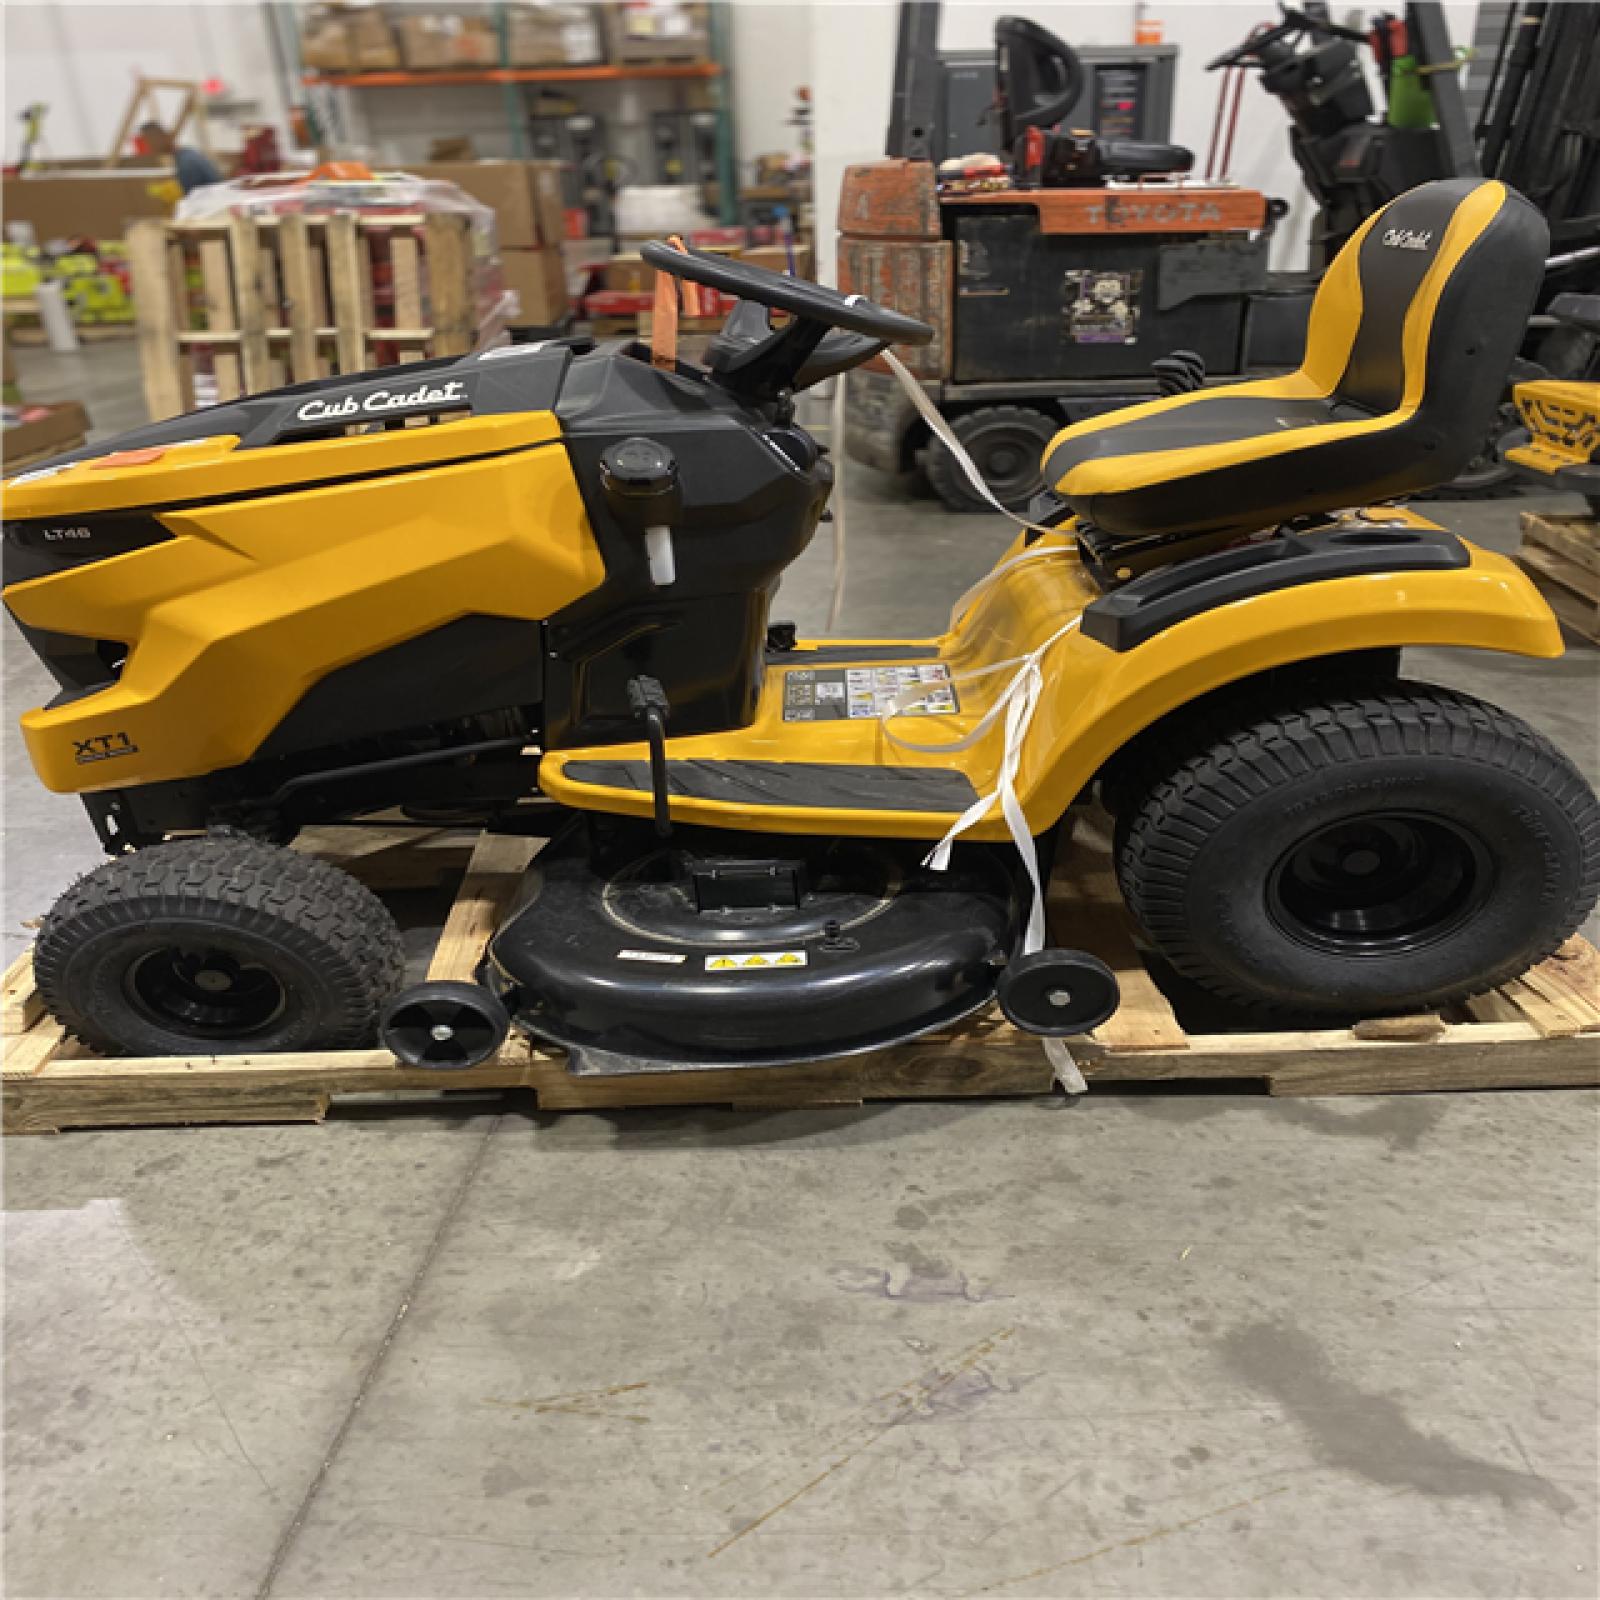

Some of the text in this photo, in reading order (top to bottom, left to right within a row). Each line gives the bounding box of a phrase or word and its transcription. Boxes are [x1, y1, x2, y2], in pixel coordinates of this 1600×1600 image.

[1085, 202, 1221, 224] TOYOTA
[297, 382, 464, 420] Cub Cadet
[72, 732, 129, 756] XT1
